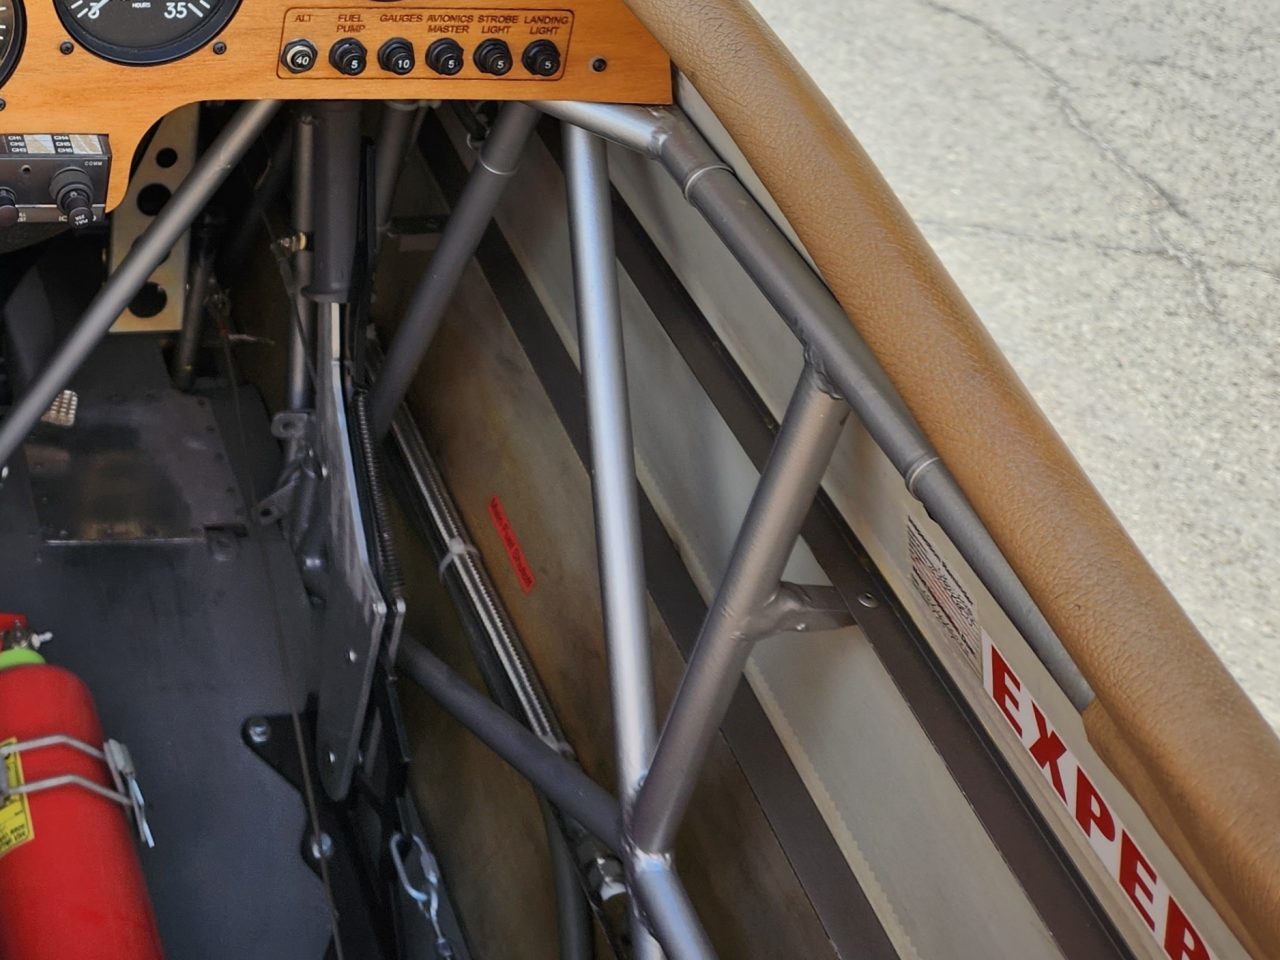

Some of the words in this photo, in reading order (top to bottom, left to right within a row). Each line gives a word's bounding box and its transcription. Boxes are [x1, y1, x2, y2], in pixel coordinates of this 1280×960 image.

[164, 2, 188, 19] 35
[295, 14, 312, 22] ALT
[338, 14, 363, 22] FUEL
[380, 14, 423, 22] GAUGES
[427, 14, 474, 23] AVIONICS
[478, 15, 518, 24] STROBE
[524, 16, 568, 24] LANDING
[336, 24, 366, 32] PUMP
[428, 26, 470, 34] MASTER
[482, 26, 512, 34] LIGHT
[296, 56, 310, 65] 40
[351, 60, 358, 68] 5
[398, 60, 410, 68] 10
[448, 60, 455, 68] 5
[497, 60, 504, 68] 5
[544, 61, 552, 69] 5
[992, 643, 1211, 960] EXPER
